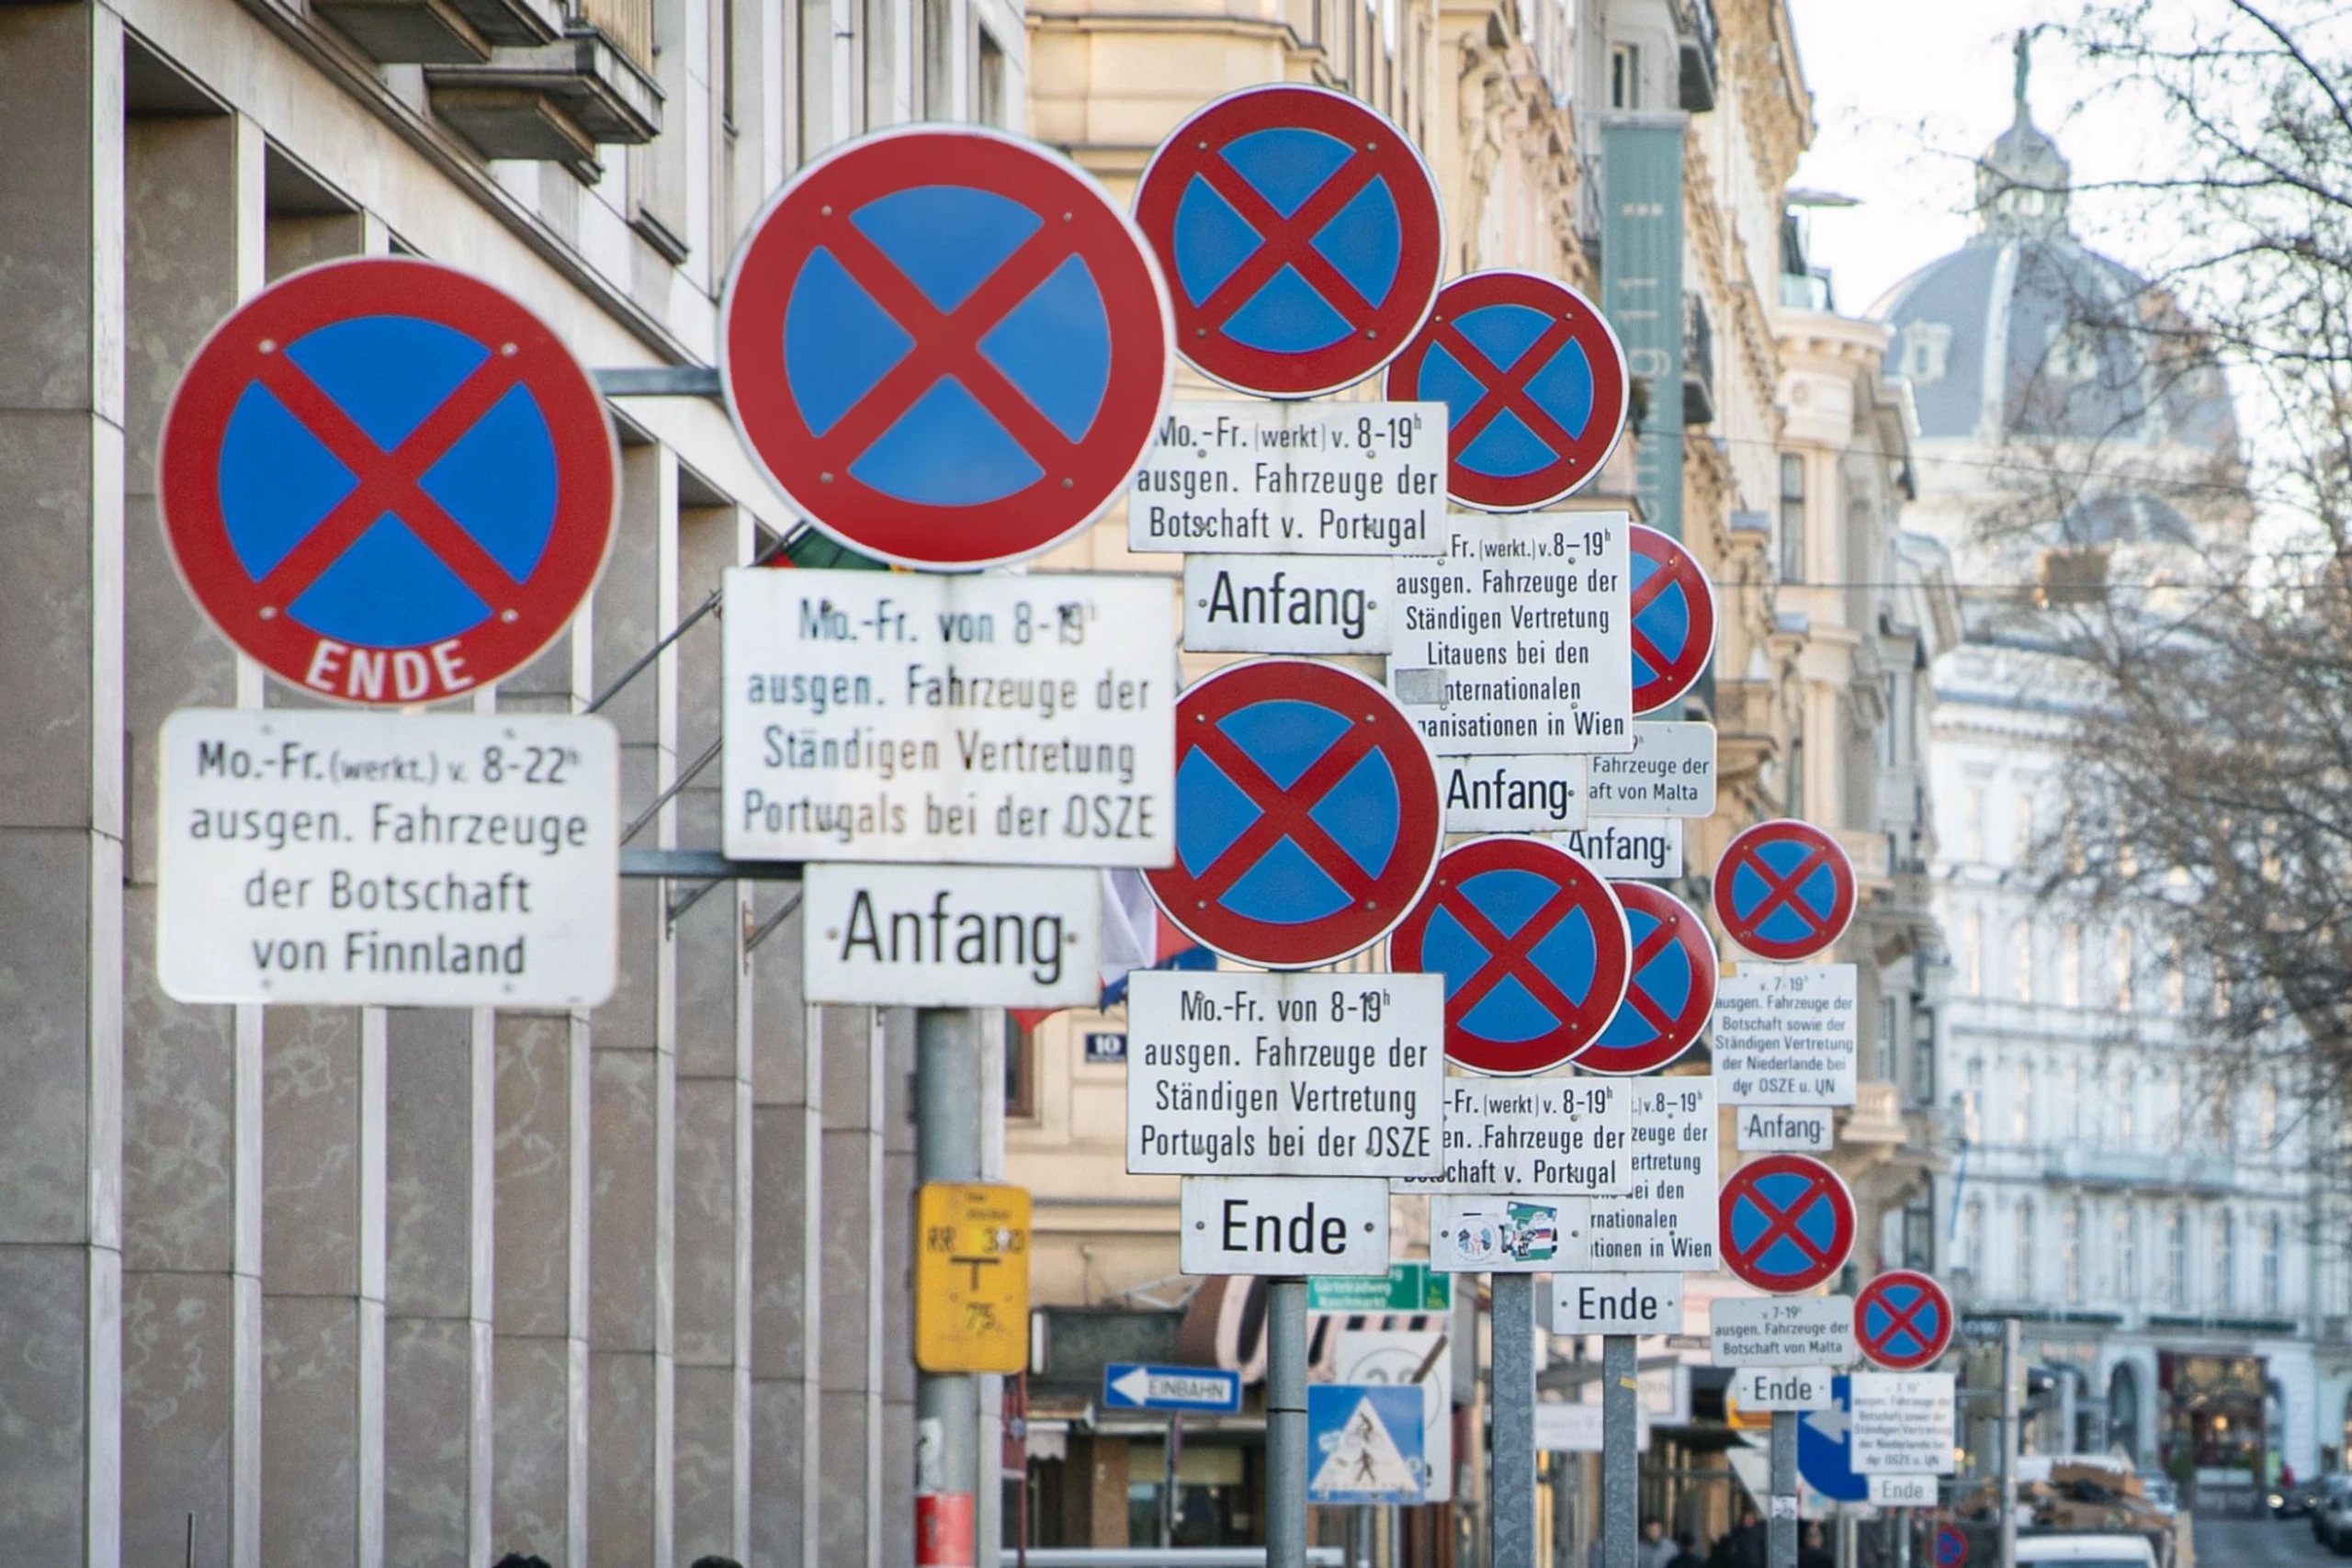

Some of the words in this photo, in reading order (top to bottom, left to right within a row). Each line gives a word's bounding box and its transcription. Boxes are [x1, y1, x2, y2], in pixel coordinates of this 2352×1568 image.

[1254, 423, 1326, 452] (werkt)
[1332, 432, 1350, 448] v.
[1137, 468, 1238, 500] ausgen.
[1255, 462, 1384, 502] Fahrzeuge
[1397, 464, 1438, 495] der
[1148, 506, 1270, 538] Botschaft
[1282, 516, 1303, 539] v.
[1319, 508, 1426, 547] Portugal
[1479, 538, 1535, 561] (werkt.)
[1539, 543, 1551, 557] v.
[1396, 576, 1470, 599] ausgen.
[1483, 570, 1577, 598] Fahrzeuge
[1588, 569, 1617, 592] der
[1207, 570, 1365, 639] Anfang
[798, 598, 918, 642] Mo.-Fr.
[939, 611, 995, 642] von
[1407, 605, 1501, 634] Ständigen
[1511, 605, 1609, 633] Vertretung
[1428, 641, 1507, 665] Litauens
[1517, 641, 1544, 663] bei
[1555, 640, 1589, 663] den
[306, 638, 475, 700] ENDE
[748, 671, 886, 714] ausgen.
[908, 664, 1077, 718] Fahrzeuge
[1097, 670, 1151, 710] der
[1444, 676, 1580, 700] nternationalen
[1419, 713, 1537, 736] anisationen
[1548, 714, 1564, 735] in
[1575, 712, 1624, 736] Wien
[198, 741, 323, 780] Mo.-Fr.
[448, 763, 468, 783] v.
[763, 726, 940, 781] Ständigen
[956, 729, 1136, 784] Vertretung
[1592, 756, 1677, 777] Fahrzeuge
[1683, 758, 1709, 774] der
[1446, 769, 1567, 819] Anfang
[1618, 785, 1647, 800] von
[1654, 784, 1698, 801] Malta
[189, 809, 353, 851] ausgen.
[372, 803, 588, 855] Fahrzeuge
[743, 789, 907, 844] Portugals
[926, 793, 976, 836] bei
[996, 795, 1048, 838] der
[1066, 795, 1157, 840] OSZE
[1568, 828, 1666, 869] Anfang
[244, 870, 313, 909] der
[330, 870, 532, 913] Botschaft
[841, 889, 1064, 986] Anfang
[253, 938, 326, 970] von
[345, 931, 526, 976] Finnland
[1181, 990, 1263, 1022] Mo.-Fr.
[1277, 998, 1317, 1021] von
[1767, 995, 1829, 1012] Fahrzeuge
[1834, 996, 1852, 1010] der
[1723, 1017, 1781, 1031] Botschaft
[1787, 1019, 1822, 1032] sowie
[1826, 1018, 1845, 1031] der
[1095, 1035, 1122, 1055] 10
[1145, 1043, 1240, 1074] ausgen.
[1256, 1036, 1375, 1074] Fahrzeuge
[1388, 1037, 1428, 1067] der
[1715, 1036, 1780, 1052] Ständigen
[1784, 1036, 1853, 1053] Vertretung
[1723, 1056, 1742, 1070] der
[1747, 1056, 1823, 1070] Niederlande
[1827, 1057, 1846, 1070] bei
[1156, 1079, 1278, 1119] Ständigen
[1290, 1081, 1416, 1121] Vertretung
[1733, 1078, 1752, 1094] der
[1759, 1078, 1794, 1093] OSZE
[1800, 1082, 1810, 1093] u.
[1815, 1078, 1835, 1093] UN
[1484, 1094, 1539, 1117] (werkt)
[1544, 1100, 1556, 1113] v.
[1645, 1102, 1655, 1112] v.
[1484, 1124, 1583, 1154] Fahrzeuge
[1594, 1126, 1624, 1148] der
[1632, 1128, 1675, 1145] zeuge
[1683, 1122, 1707, 1142] der
[1748, 1113, 1820, 1144] Anfang
[1141, 1125, 1255, 1163] Portugals
[1269, 1126, 1304, 1156] bei
[1317, 1126, 1356, 1157] der
[1367, 1126, 1430, 1158] OSZE
[1504, 1167, 1521, 1183] v.
[1534, 1159, 1615, 1189] Portugal
[1632, 1155, 1701, 1175] ertretung
[1657, 1180, 1685, 1200] den
[1222, 1199, 1347, 1255] Ende
[1590, 1209, 1677, 1228] rnationalen
[1650, 1237, 1664, 1258] in
[1672, 1237, 1712, 1258] Wien
[1579, 1287, 1657, 1320] Ende
[1765, 1322, 1826, 1337] Fahrzeuge
[1830, 1322, 1849, 1333] der
[1724, 1341, 1780, 1355] Botschaft
[1784, 1344, 1805, 1353] von
[1809, 1341, 1842, 1353] Malta
[1149, 1382, 1225, 1400] EINBAHN
[1755, 1376, 1812, 1401] Ende
[1882, 1480, 1924, 1499] Ende
